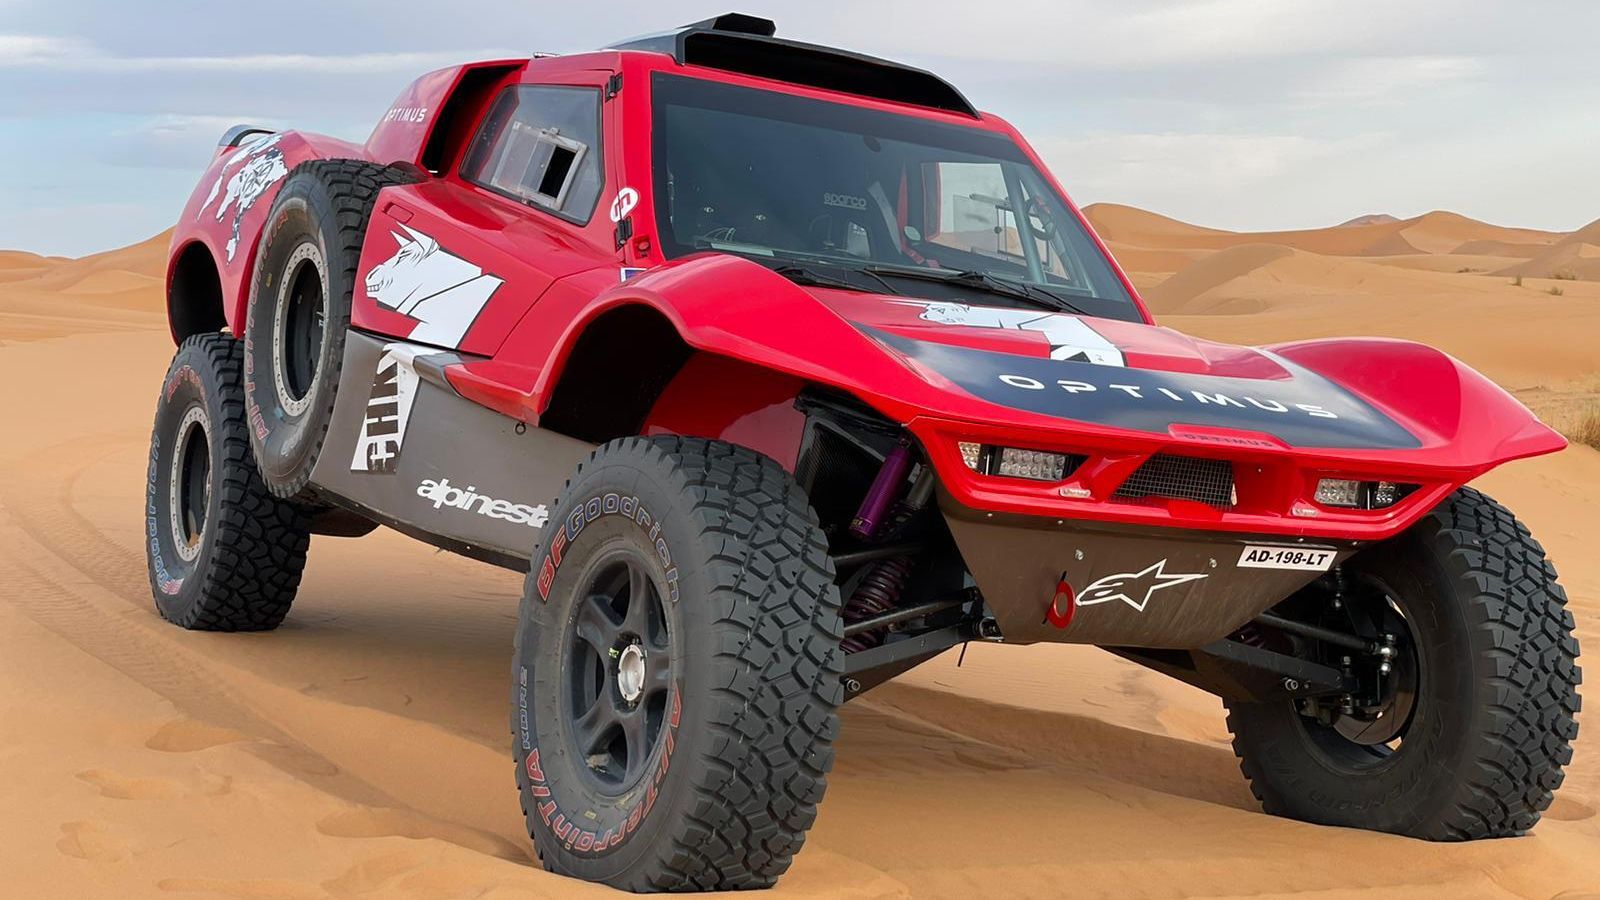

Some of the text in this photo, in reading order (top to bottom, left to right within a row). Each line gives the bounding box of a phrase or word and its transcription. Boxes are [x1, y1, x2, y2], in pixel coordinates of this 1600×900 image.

[823, 193, 866, 208] sparco
[998, 373, 1338, 418] OPTIMUS
[1184, 434, 1272, 447] OPTIMUS
[536, 493, 680, 602] BFGoodrich
[1245, 549, 1329, 566] AD-198-LT
[552, 678, 682, 851] All-Terrain
